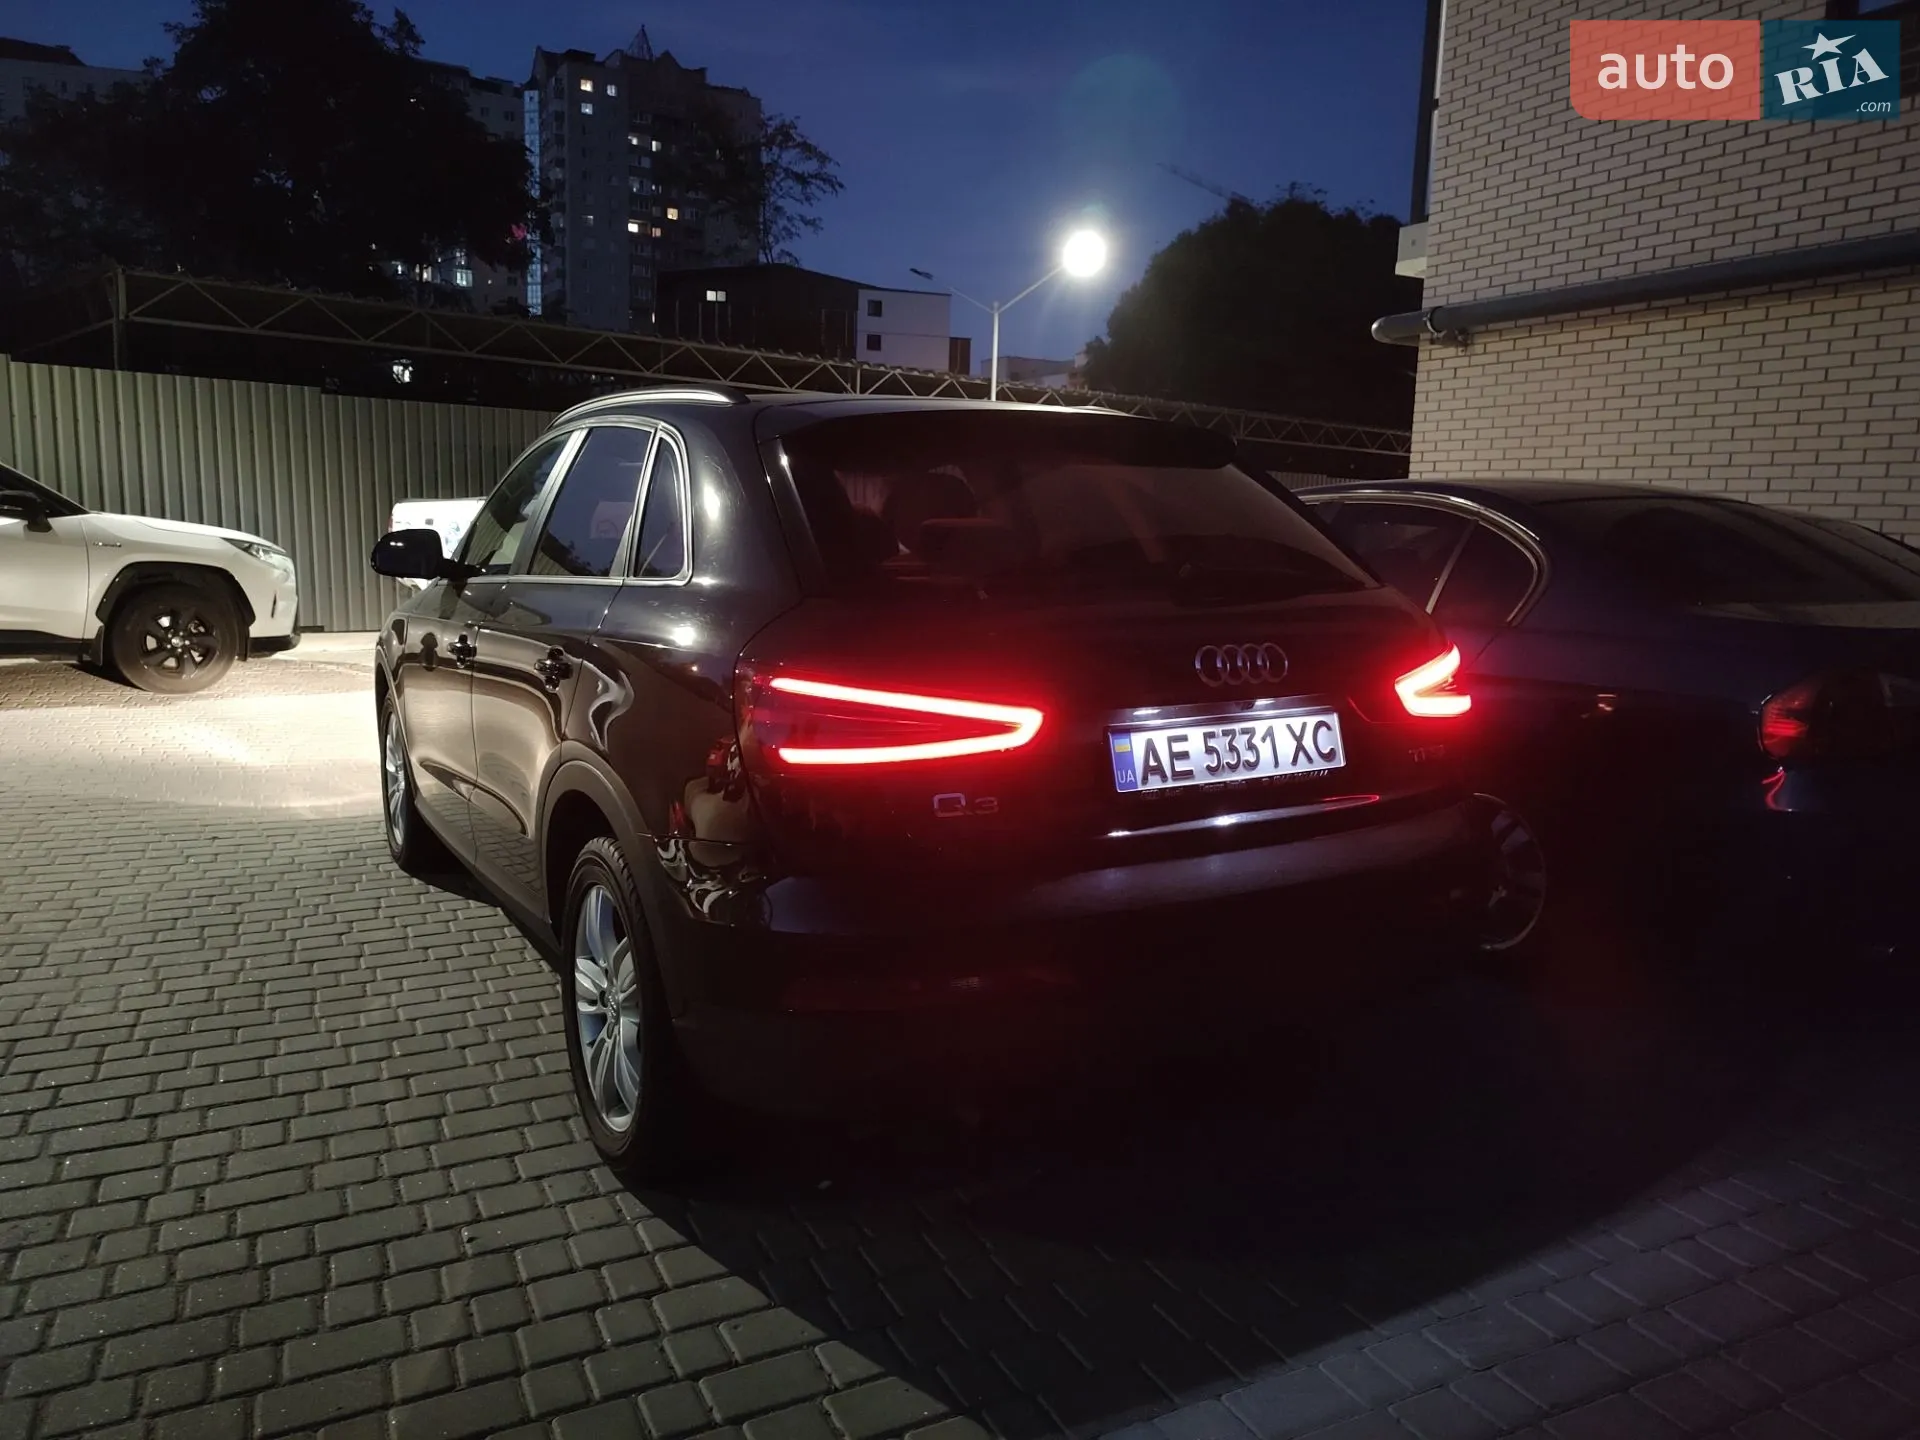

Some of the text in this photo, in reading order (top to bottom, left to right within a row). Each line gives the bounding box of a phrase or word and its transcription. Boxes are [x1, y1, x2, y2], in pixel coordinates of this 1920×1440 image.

[1141, 719, 1337, 786] AE 5331 XC
[1117, 769, 1136, 785] UA
[933, 792, 999, 818] Q3
